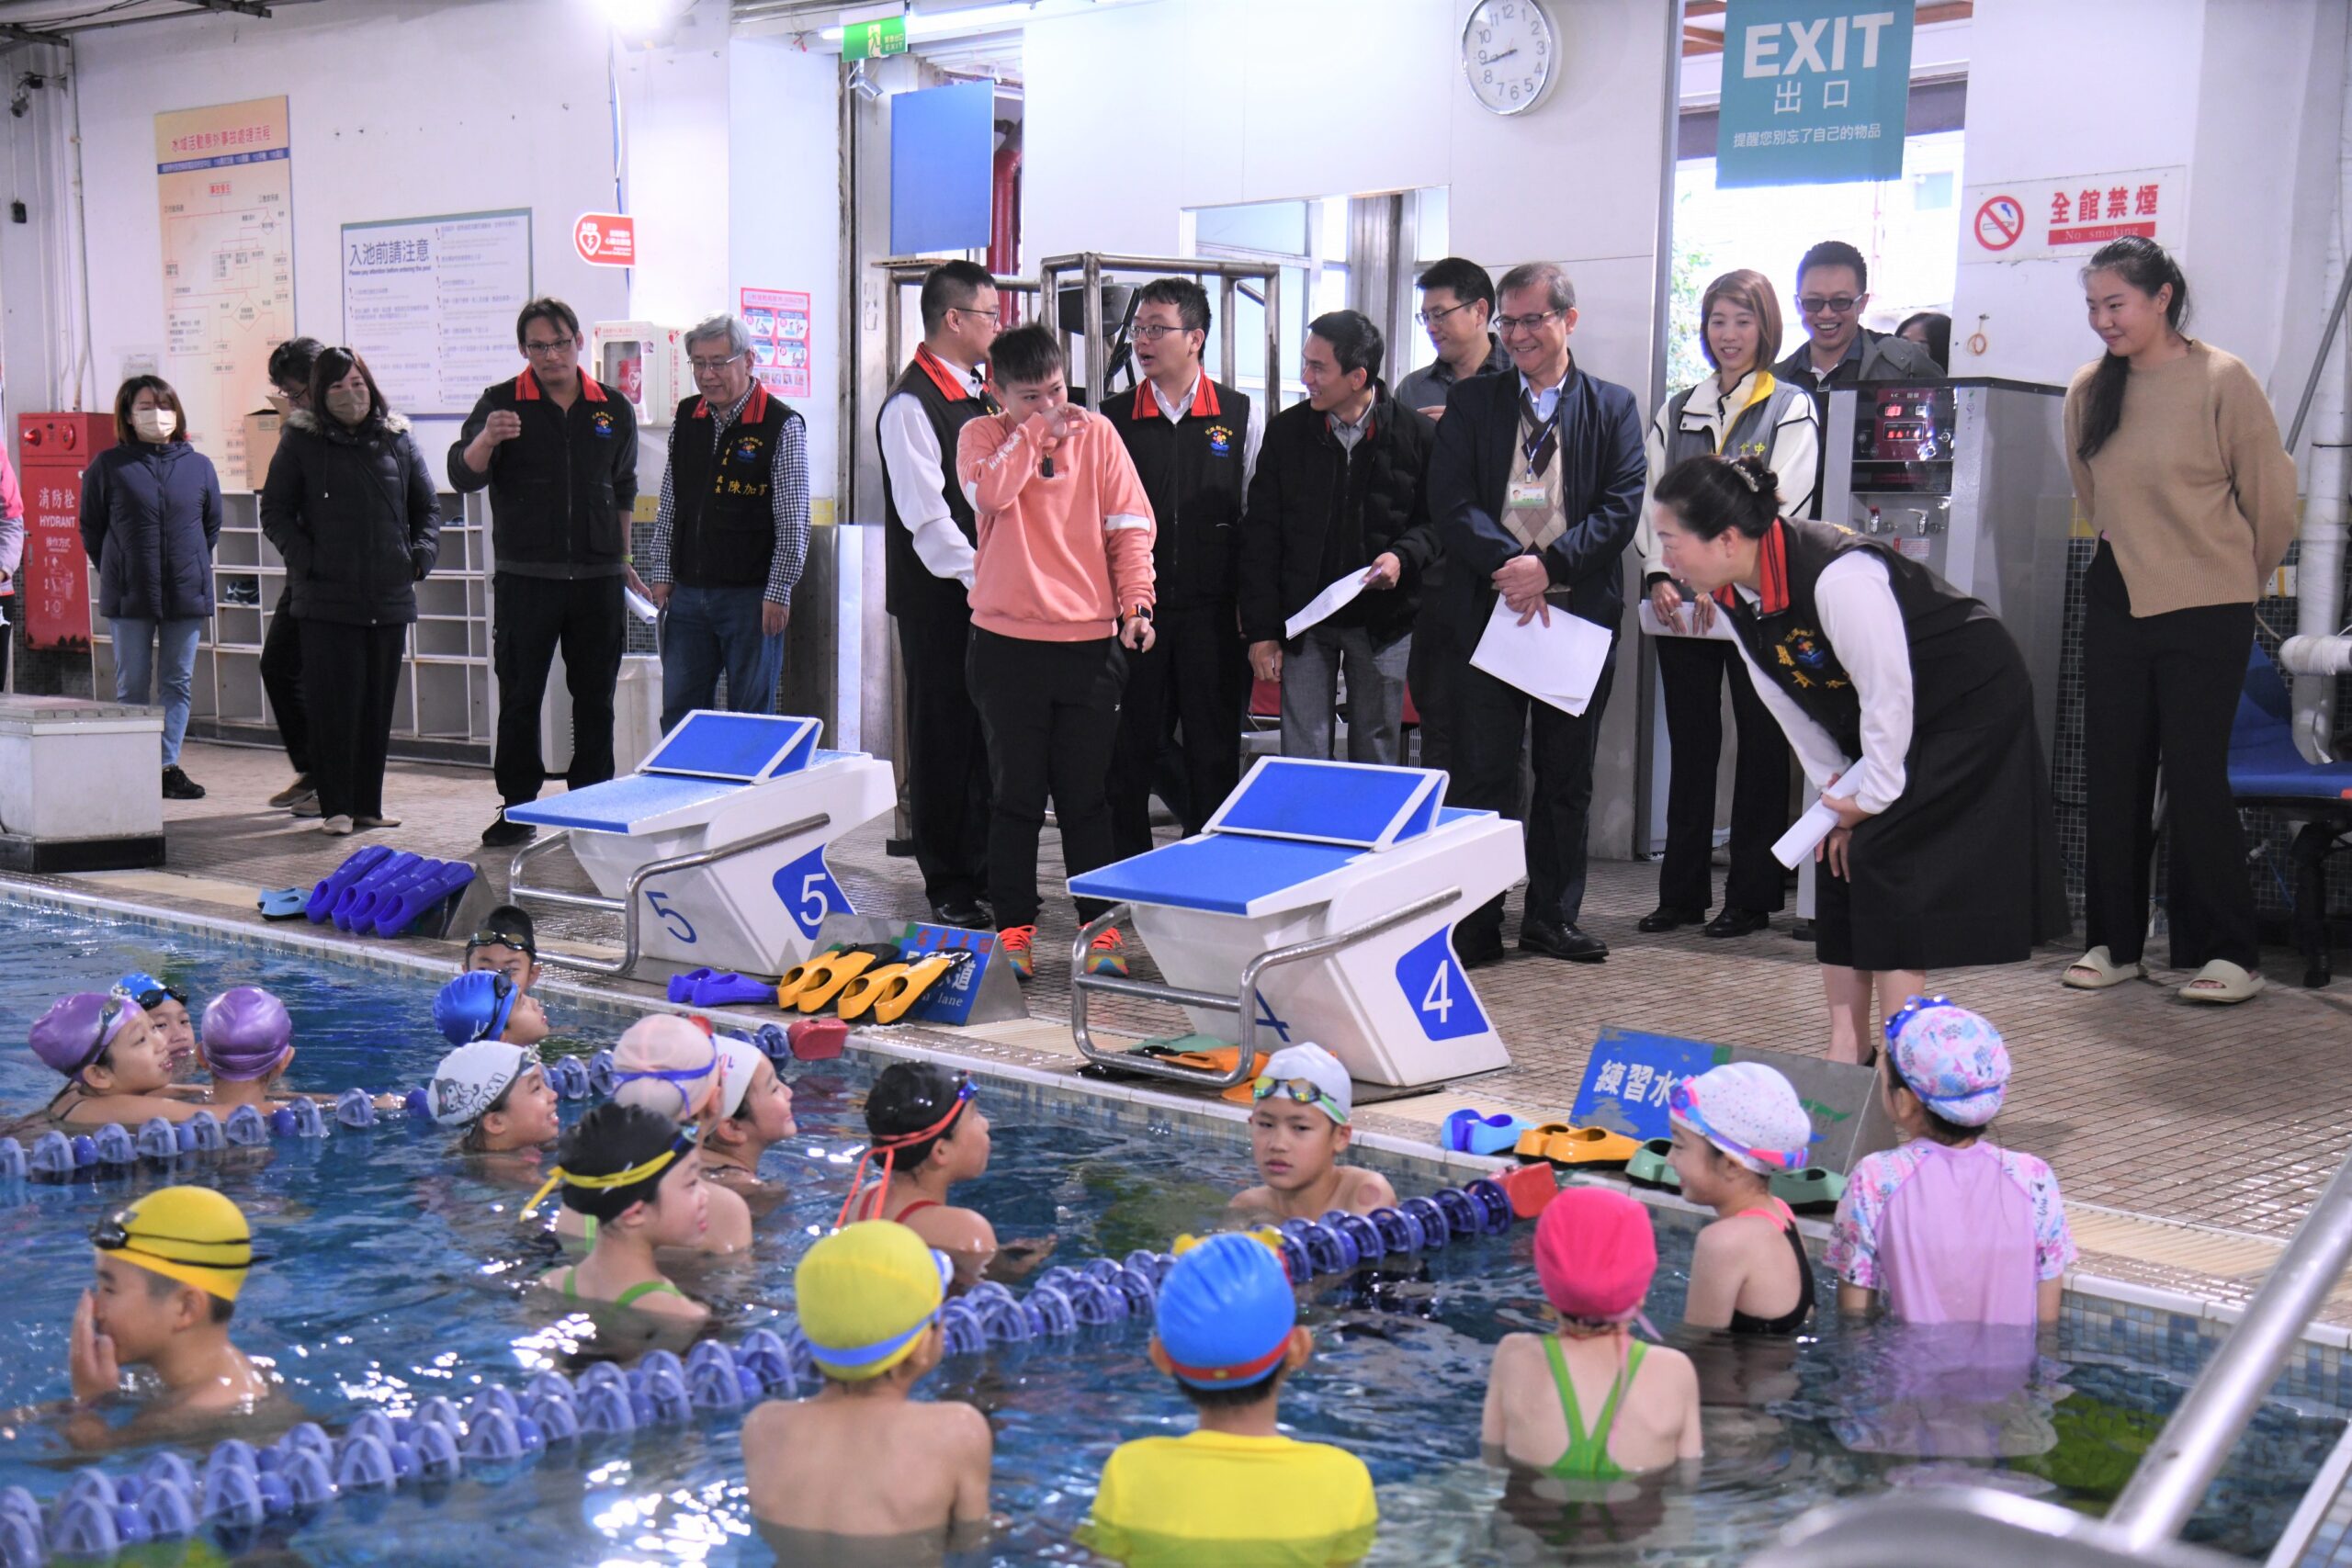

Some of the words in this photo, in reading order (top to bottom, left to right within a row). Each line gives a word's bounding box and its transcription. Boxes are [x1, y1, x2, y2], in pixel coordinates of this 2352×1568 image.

[1502, 4, 1514, 18] 12
[1521, 8, 1526, 22] 1
[1489, 14, 1499, 27] 11
[1531, 21, 1540, 36] 2
[1476, 28, 1492, 45] 10
[885, 42, 903, 51] EXIT
[1536, 40, 1545, 55] 3
[1743, 11, 1894, 78] EXIT
[1478, 50, 1487, 65] 9
[1534, 62, 1543, 75] 4
[1484, 70, 1493, 84] 8
[1497, 82, 1505, 96] 7
[1510, 85, 1520, 100] 6
[1524, 78, 1533, 93] 5
[1774, 80, 1849, 114] 出口
[1733, 123, 1881, 148] 提醒您別忘了自己的物品
[2050, 185, 2159, 224] 全館禁煙
[2065, 231, 2081, 241] No
[2089, 226, 2139, 240] smoking
[349, 238, 430, 266] 入池前請注意
[39, 488, 75, 510] 消防栓
[40, 515, 75, 528] HYDRANT
[800, 873, 826, 926] 5
[644, 890, 697, 944] 5
[1422, 959, 1453, 1023] 4
[938, 992, 963, 1007] lane
